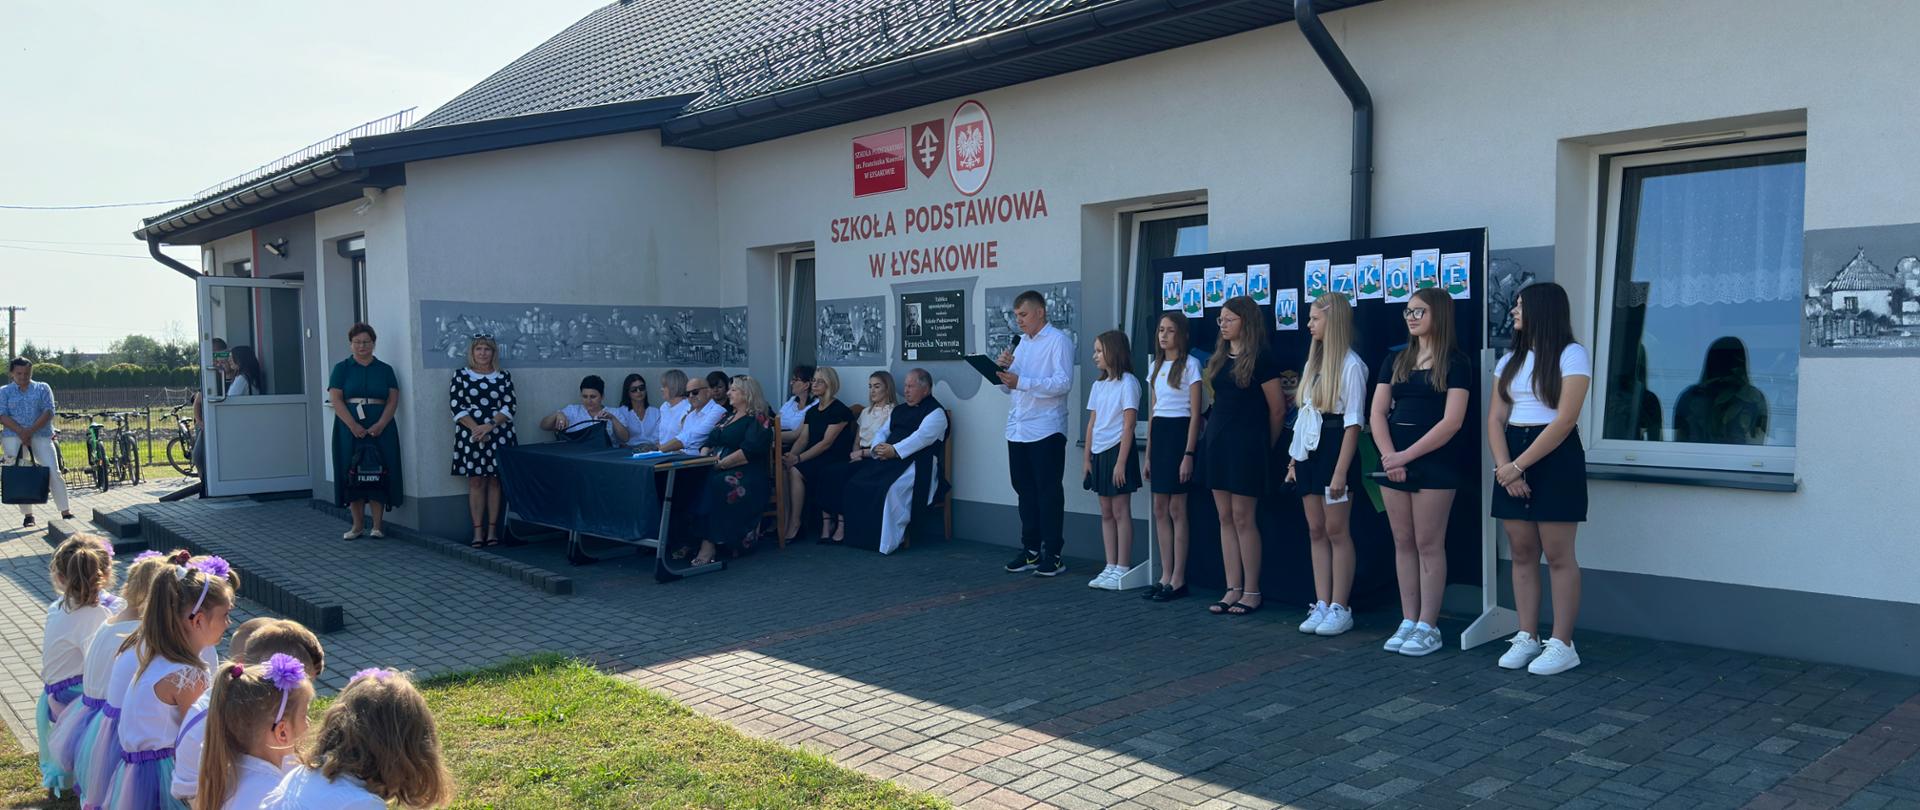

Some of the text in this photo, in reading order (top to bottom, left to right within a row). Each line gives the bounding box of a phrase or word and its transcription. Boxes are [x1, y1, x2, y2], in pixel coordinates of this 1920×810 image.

[831, 189, 1048, 243] SZKOŁA PODSTAWOWA
[869, 241, 998, 278] W ŁYSAKOWIE
[1167, 262, 1461, 318] WITAJ W SZKOLE
